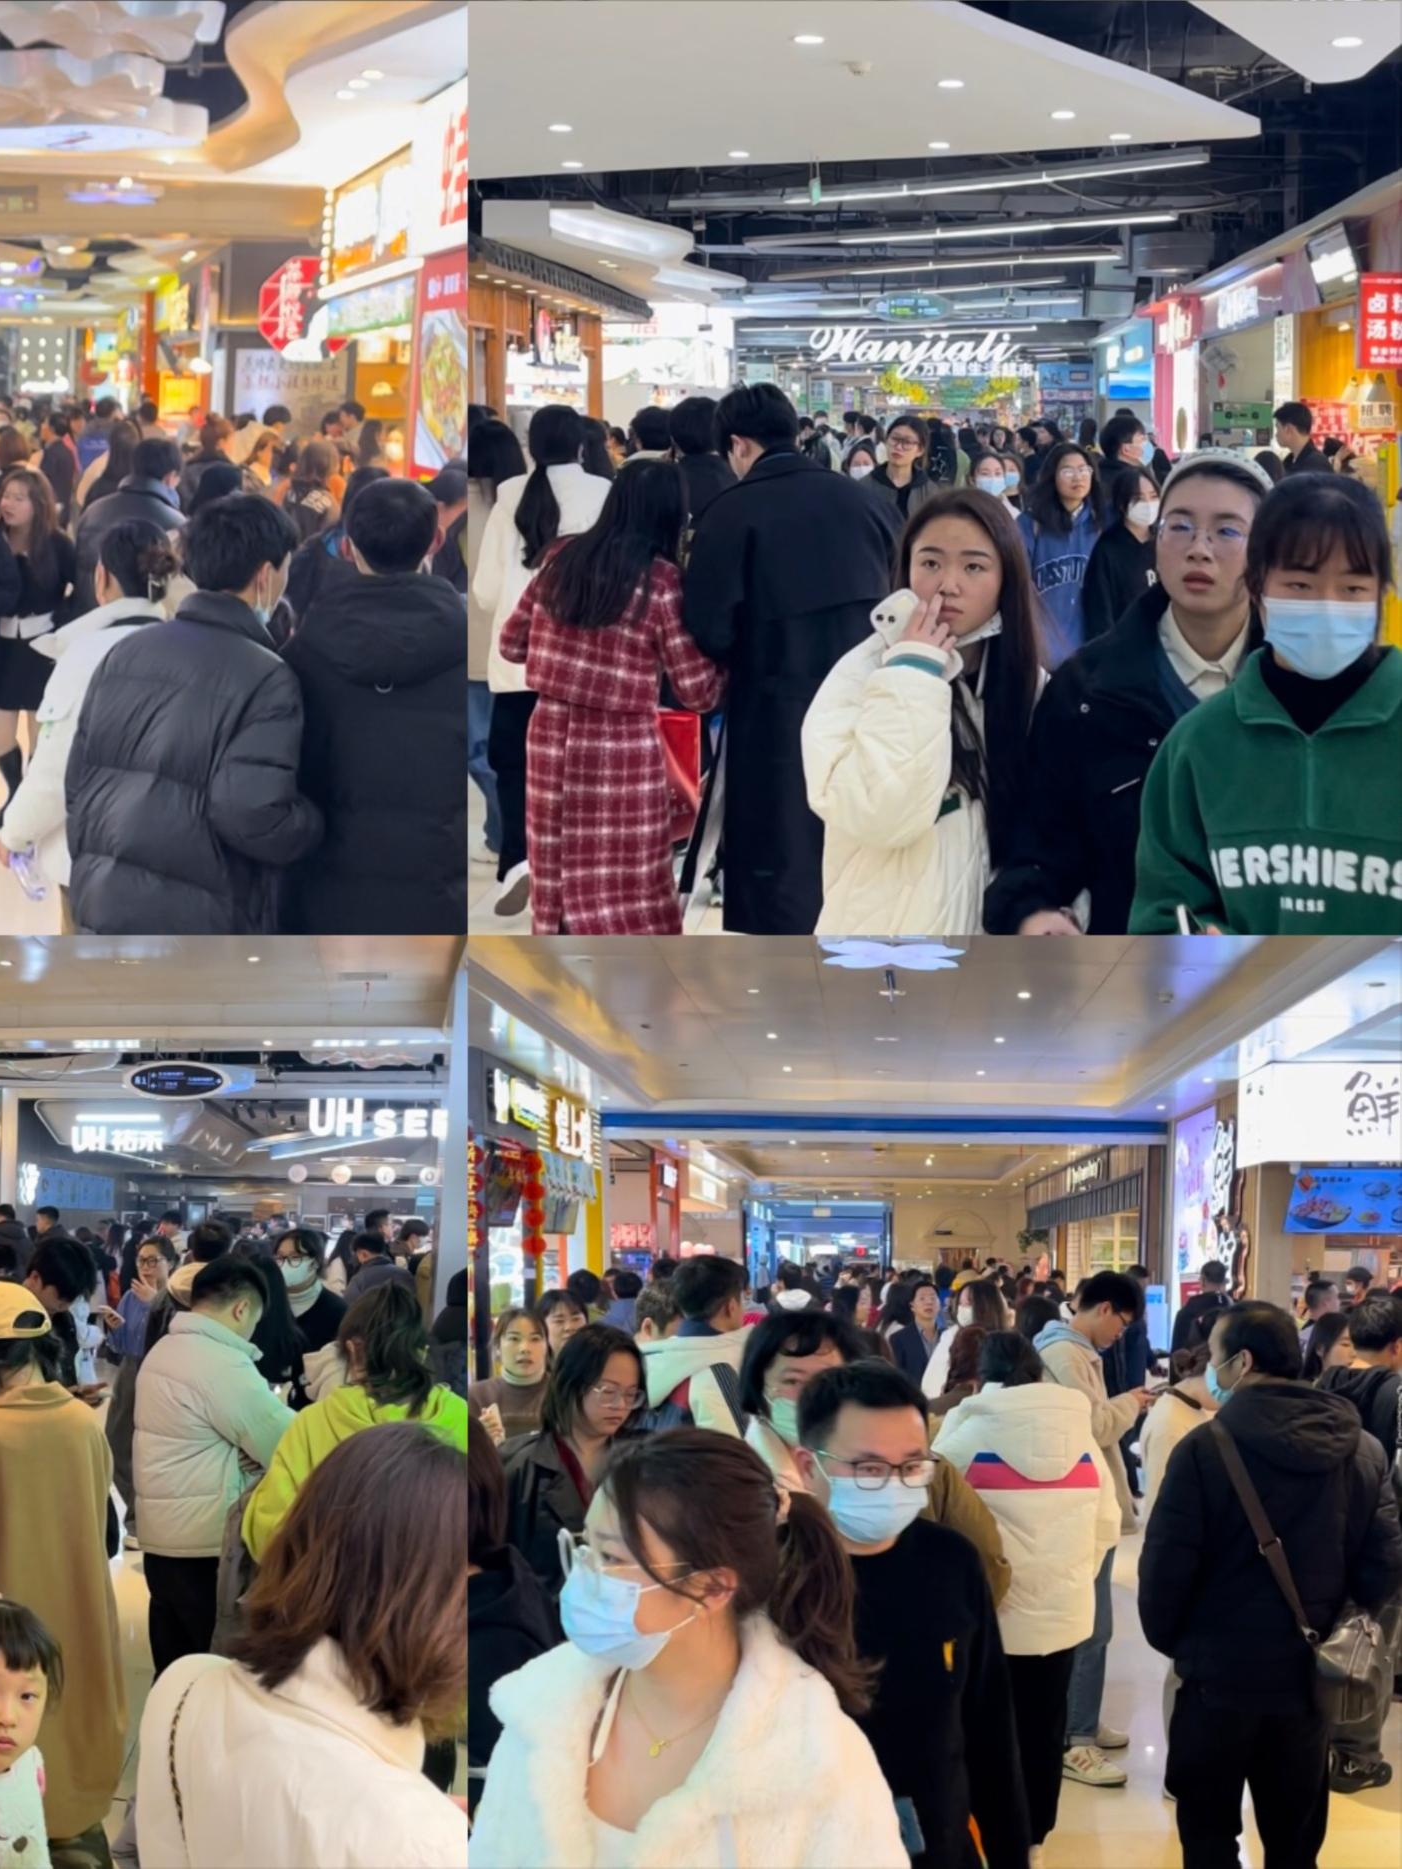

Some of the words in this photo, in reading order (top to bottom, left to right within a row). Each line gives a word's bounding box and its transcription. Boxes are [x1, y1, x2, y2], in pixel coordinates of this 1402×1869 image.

[809, 326, 1021, 377] Wanjiali
[1210, 846, 1402, 901] ERSHIERS
[309, 1097, 364, 1137] UH
